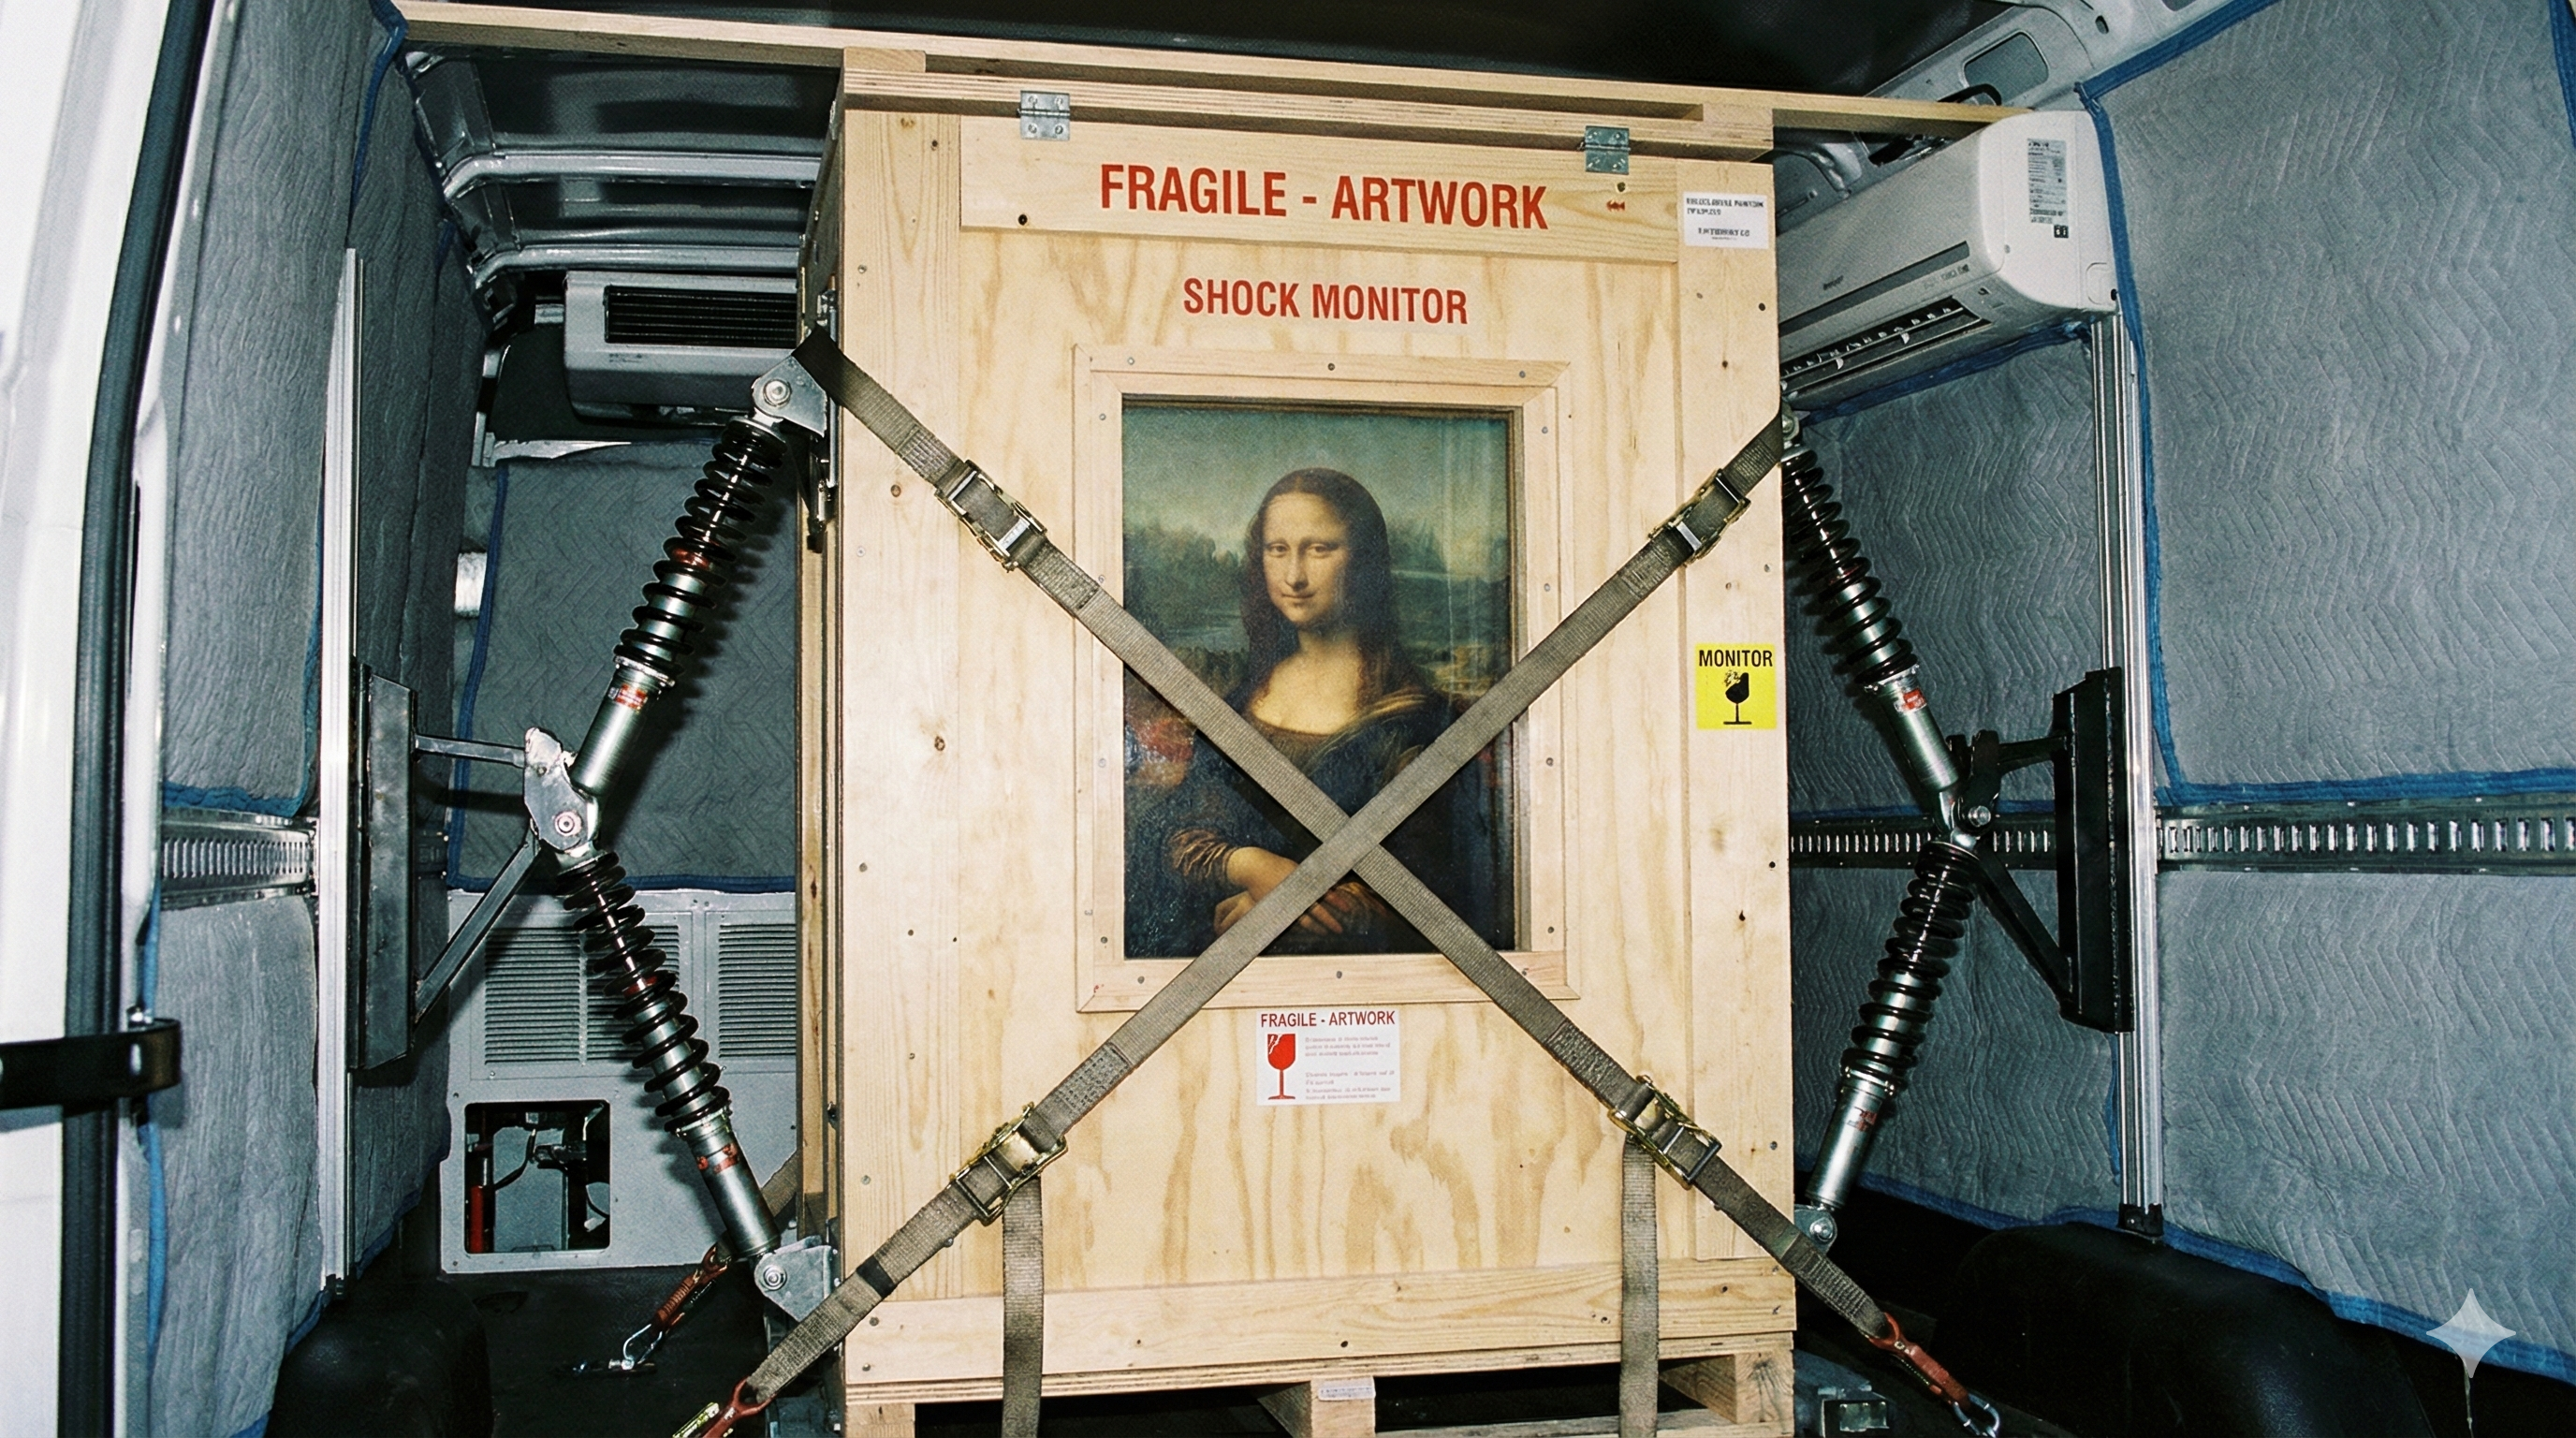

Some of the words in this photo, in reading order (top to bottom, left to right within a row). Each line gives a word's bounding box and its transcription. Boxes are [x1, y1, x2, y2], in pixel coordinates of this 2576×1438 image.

[1101, 164, 1286, 216] FRAGILE
[1332, 175, 1548, 229] ARTWORK
[1184, 278, 1299, 317] SHOCK
[1311, 284, 1467, 324] MONITOR
[1698, 649, 1773, 668] MONITOR
[1261, 1012, 1317, 1027] FRAGILE
[1328, 1011, 1396, 1026] ARTWORK
